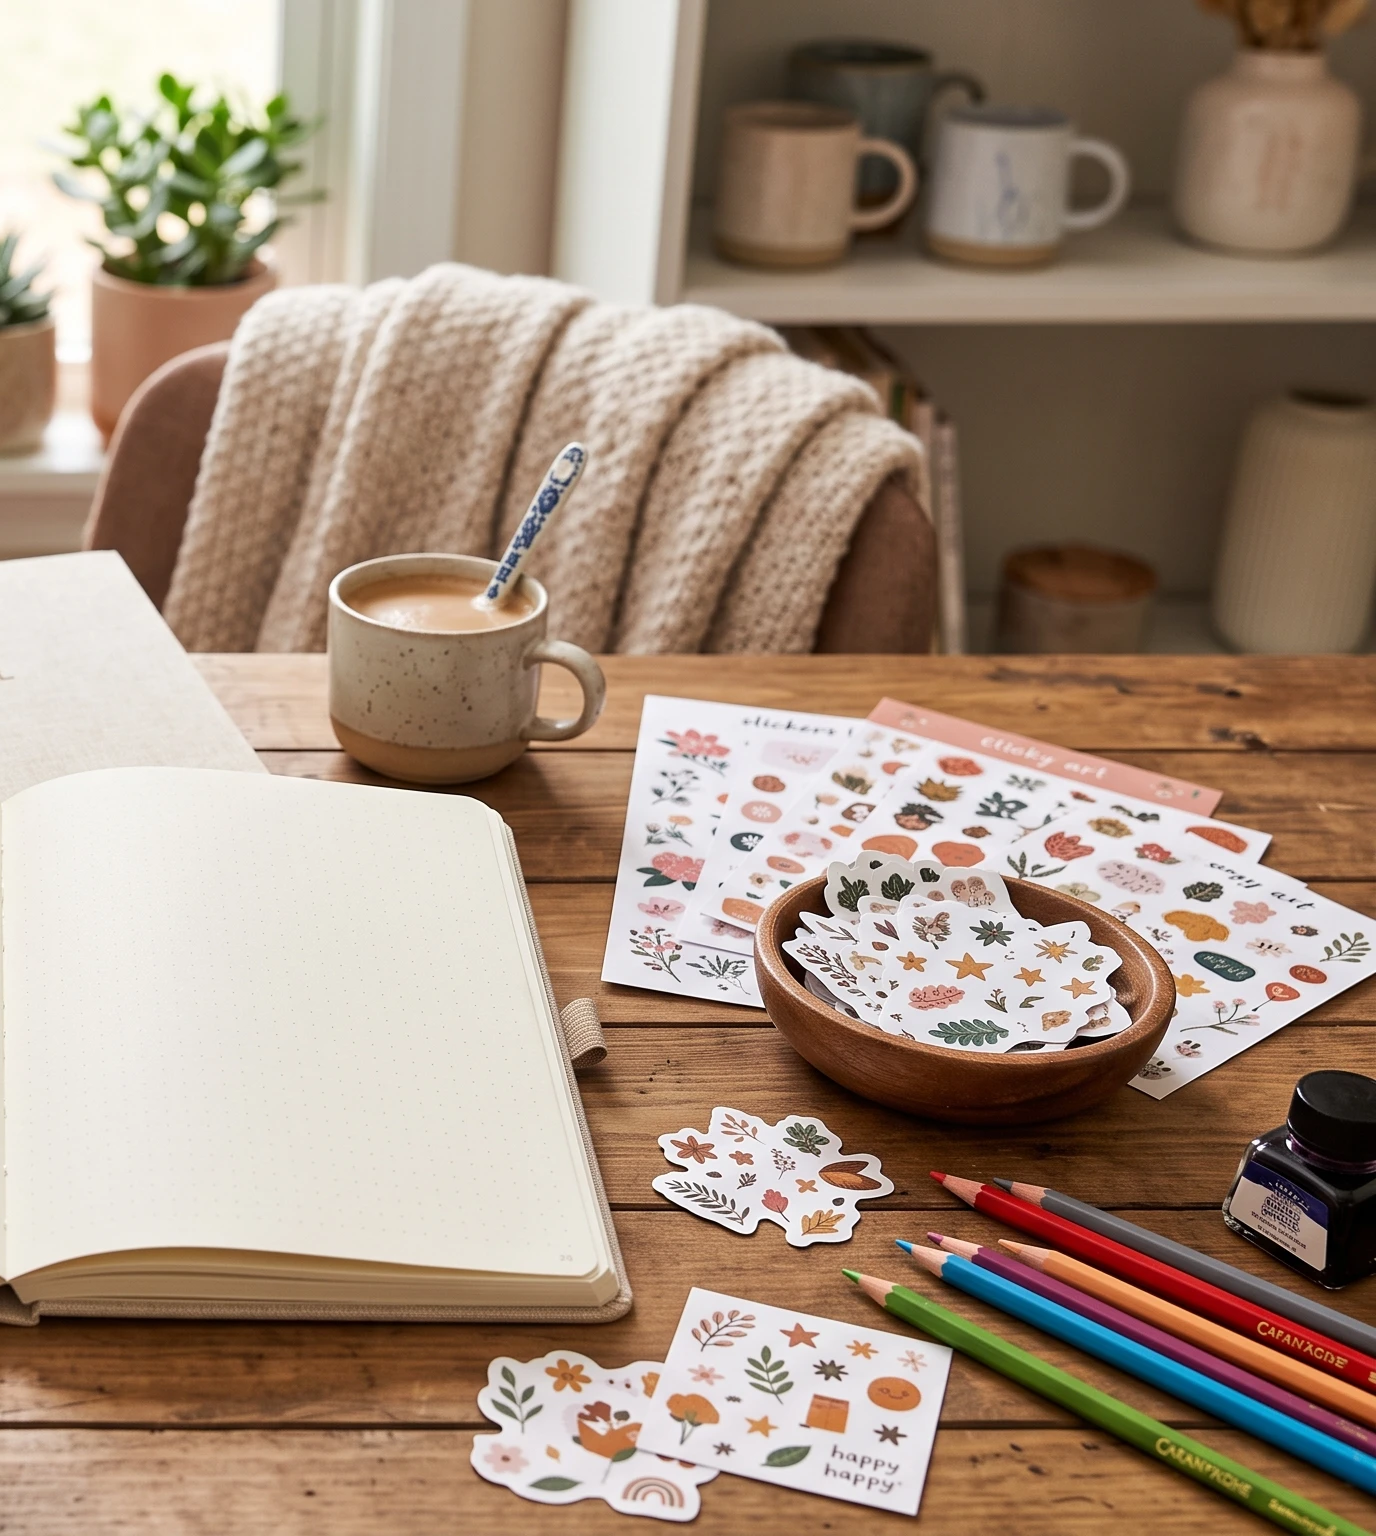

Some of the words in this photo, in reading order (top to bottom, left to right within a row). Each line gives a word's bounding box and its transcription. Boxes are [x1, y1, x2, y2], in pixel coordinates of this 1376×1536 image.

[1063, 761, 1109, 780] art
[1270, 891, 1317, 911] art
[831, 1444, 900, 1476] happy
[824, 1463, 895, 1494] happy
